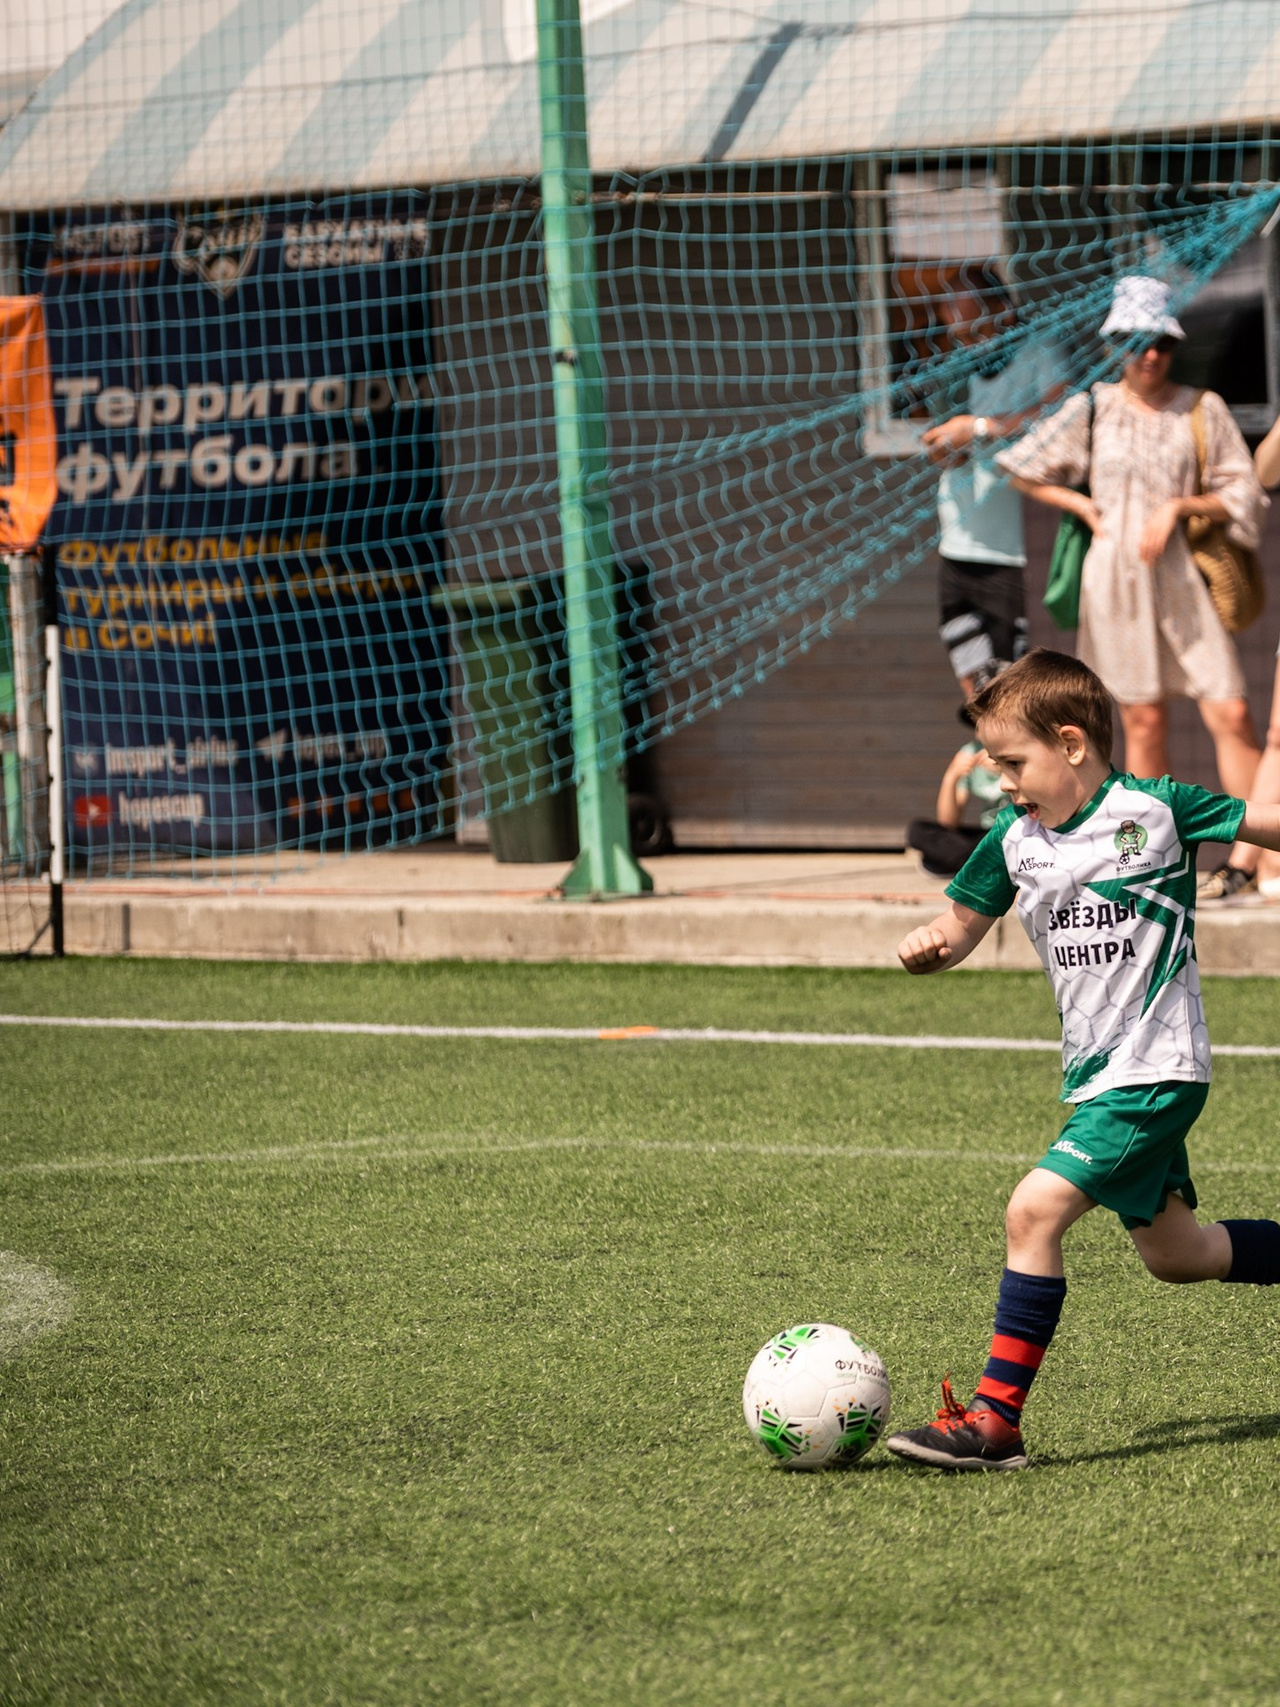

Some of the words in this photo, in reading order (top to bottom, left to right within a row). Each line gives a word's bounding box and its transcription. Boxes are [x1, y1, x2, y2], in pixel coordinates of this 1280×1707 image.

[284, 241, 384, 270] СЕЗОНЫ
[1048, 898, 1137, 931] ЗВЁЗДЫ
[1054, 938, 1136, 970] ЦЕНТРА
